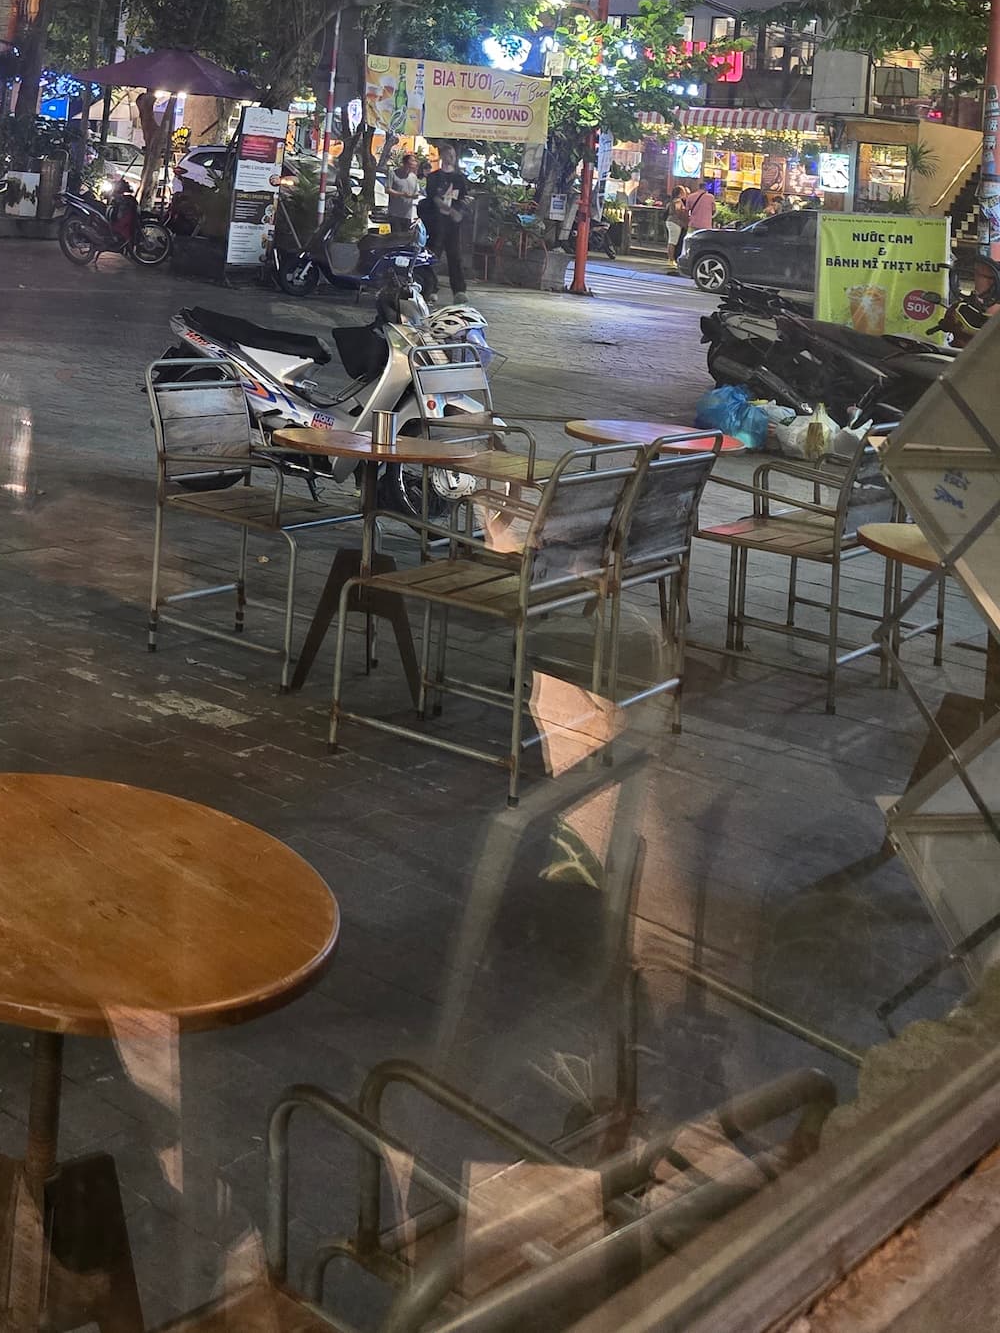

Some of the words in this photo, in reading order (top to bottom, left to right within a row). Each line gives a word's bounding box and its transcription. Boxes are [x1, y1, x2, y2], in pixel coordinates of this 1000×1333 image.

[433, 69, 456, 87] BIA
[460, 72, 493, 91] TƯƠI
[471, 106, 529, 122] 25,000VND
[888, 234, 913, 244] CAM
[878, 247, 887, 256] &
[826, 256, 859, 268] BÁNH
[881, 261, 912, 274] THỊT
[906, 301, 930, 315] 50K
